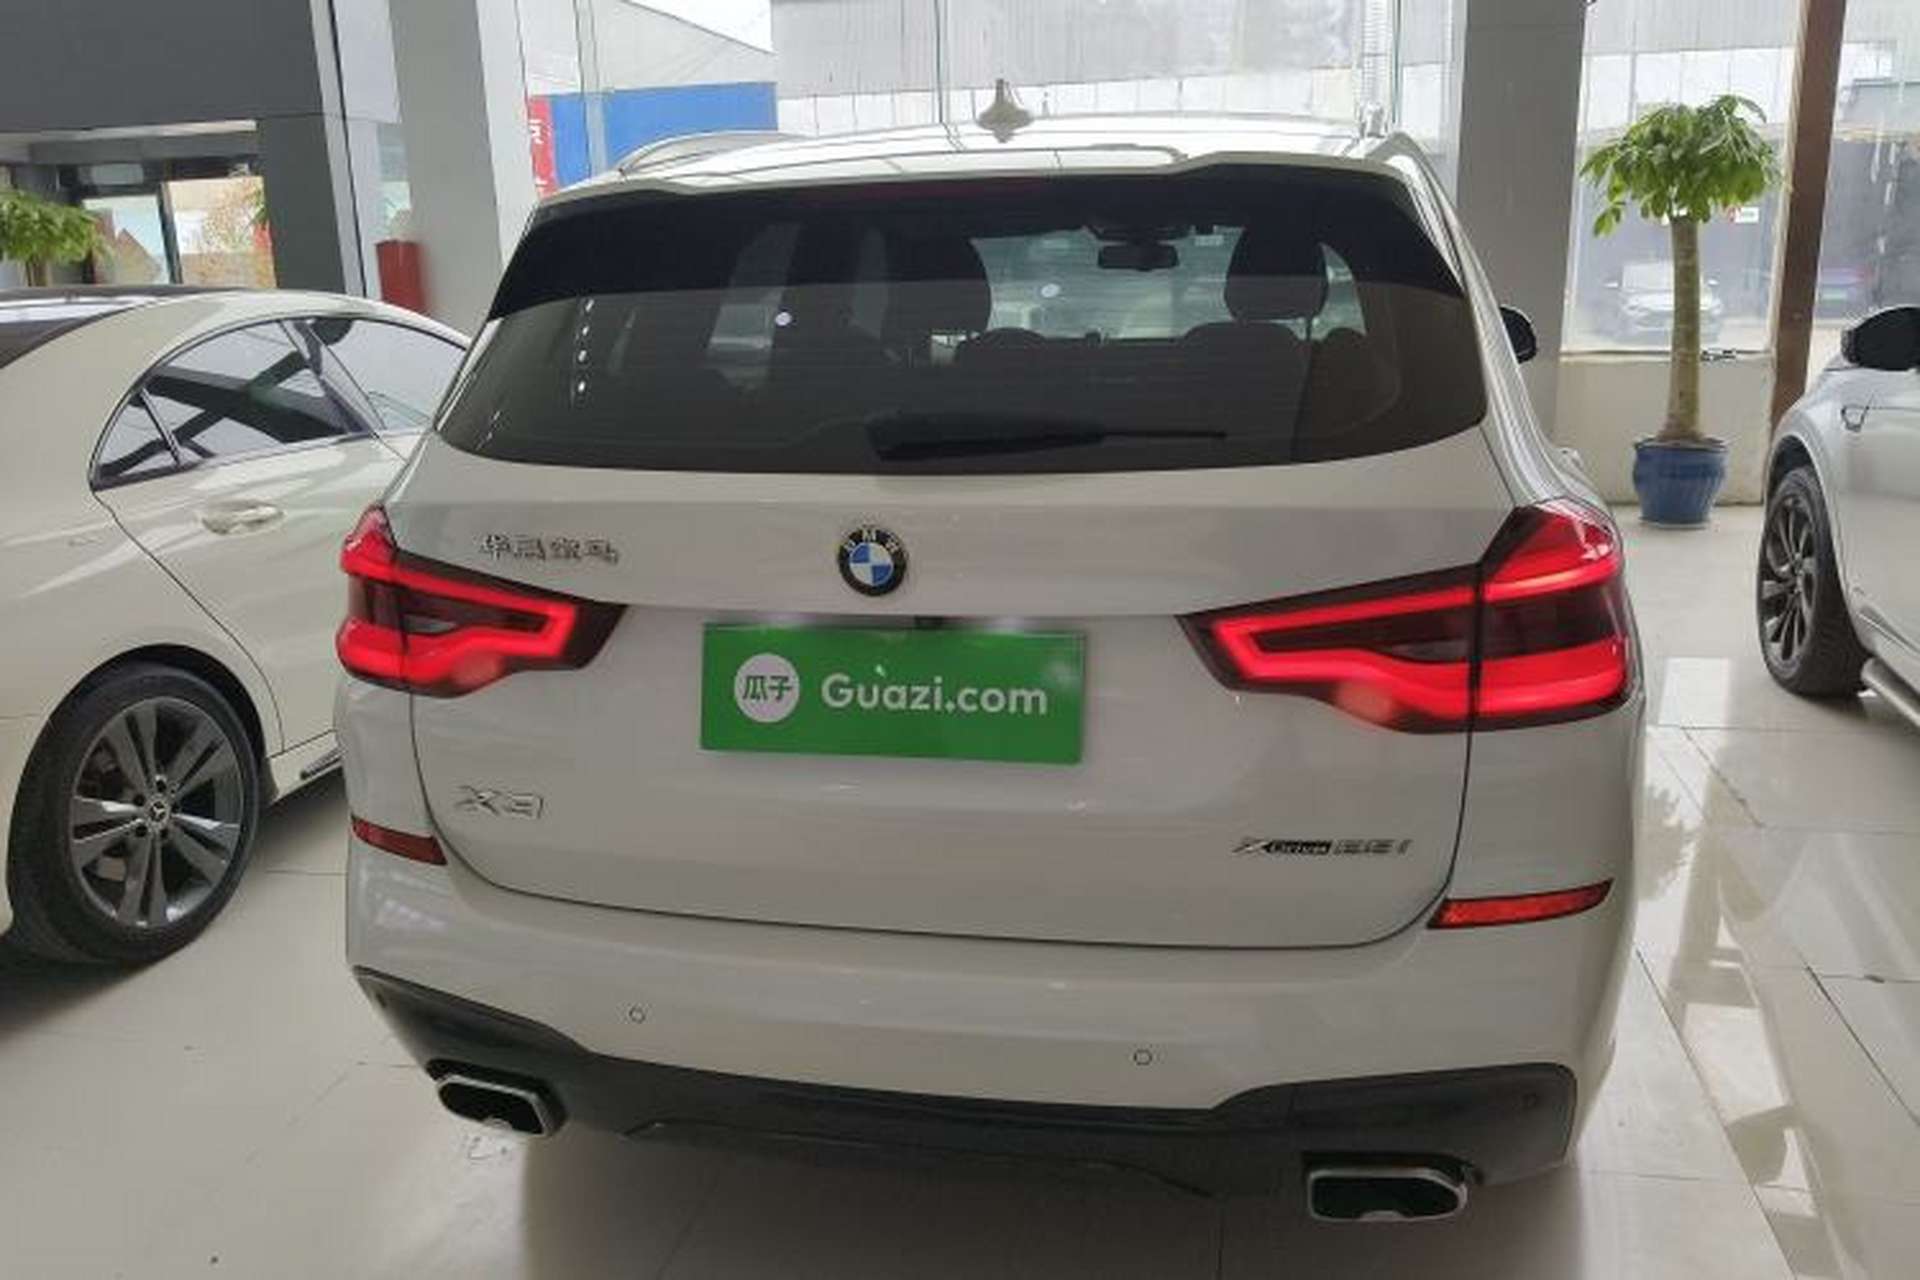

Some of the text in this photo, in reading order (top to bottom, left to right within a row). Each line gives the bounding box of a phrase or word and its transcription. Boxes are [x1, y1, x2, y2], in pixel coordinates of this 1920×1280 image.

[742, 674, 793, 701] 瓜子
[821, 672, 1048, 715] Guazi.com
[453, 785, 544, 819] X3
